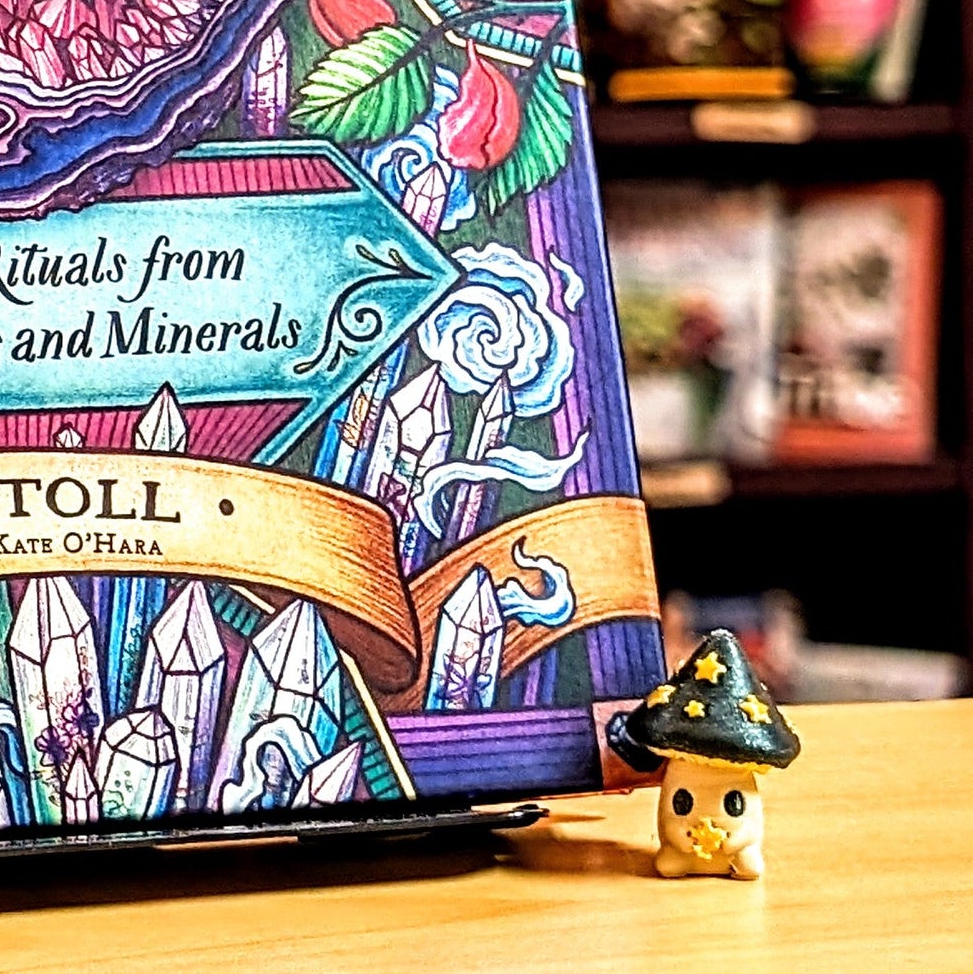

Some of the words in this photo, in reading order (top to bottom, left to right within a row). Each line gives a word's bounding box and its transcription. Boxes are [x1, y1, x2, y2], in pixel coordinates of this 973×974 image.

[117, 235, 245, 303] from
[11, 311, 95, 362] and
[100, 302, 302, 359] Minerals
